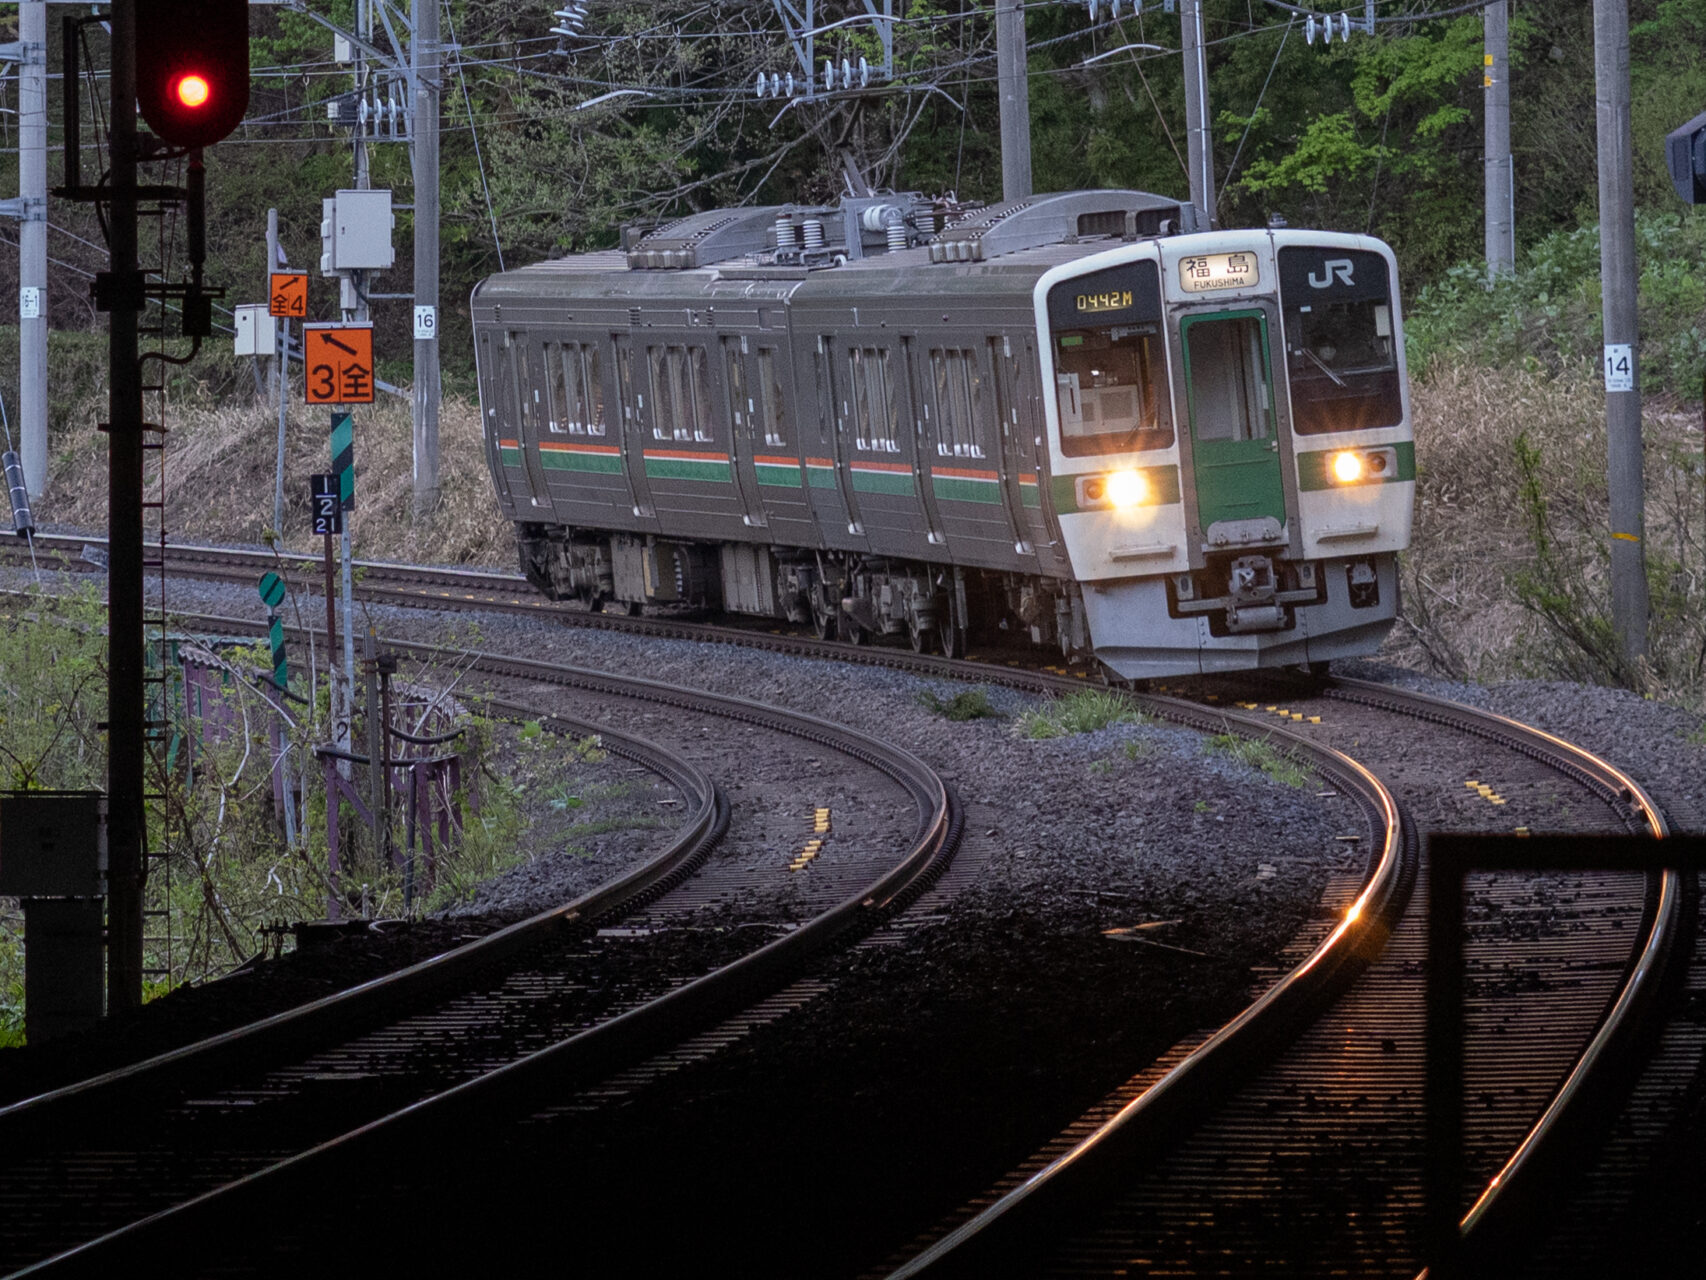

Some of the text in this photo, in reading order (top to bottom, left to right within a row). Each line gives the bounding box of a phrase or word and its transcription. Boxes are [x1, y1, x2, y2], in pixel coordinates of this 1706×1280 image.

[1308, 258, 1356, 288] JR
[1194, 277, 1245, 290] FUKUSHIMA
[1077, 291, 1133, 310] 0442M
[417, 313, 433, 328] 16
[1607, 356, 1630, 376] 14
[315, 517, 335, 533] 21
